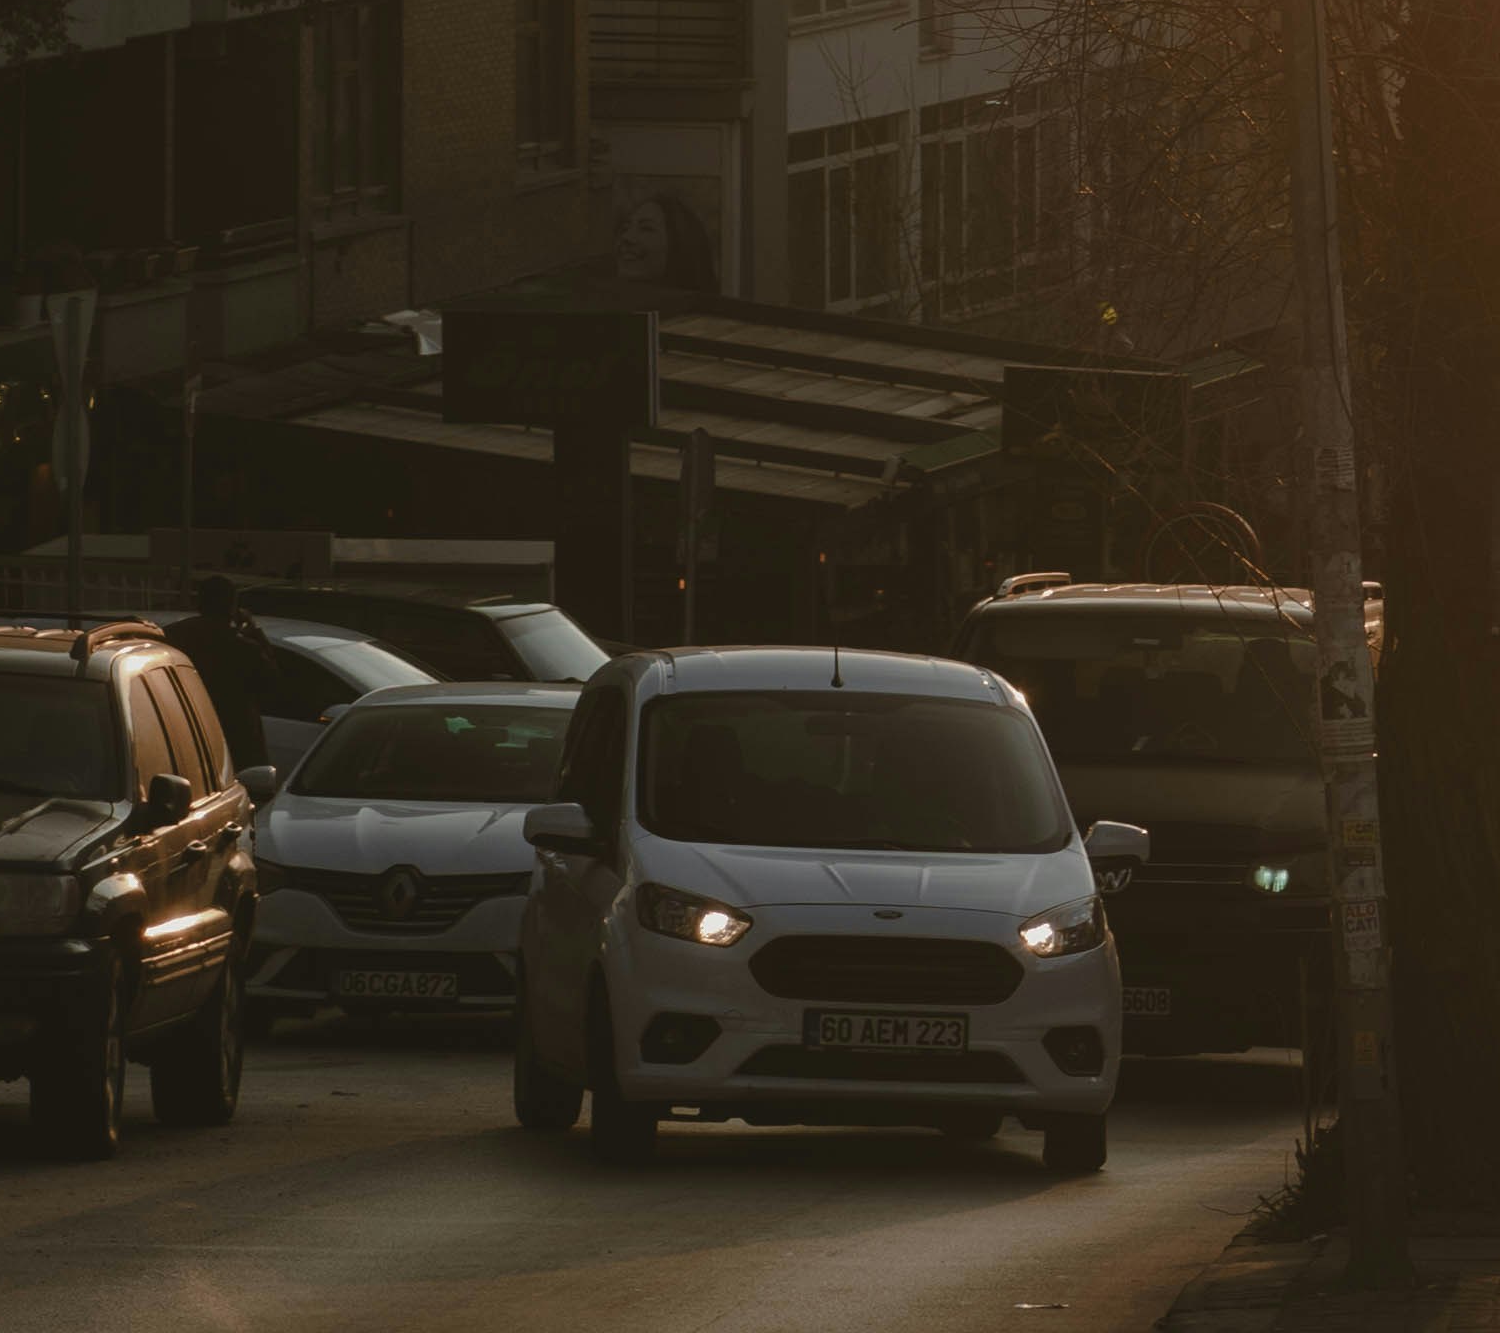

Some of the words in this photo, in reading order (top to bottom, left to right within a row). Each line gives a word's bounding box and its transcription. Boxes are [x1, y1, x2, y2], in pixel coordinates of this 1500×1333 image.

[821, 1016, 852, 1043] 60
[860, 1018, 909, 1045] AEM
[916, 1020, 962, 1047] 223
